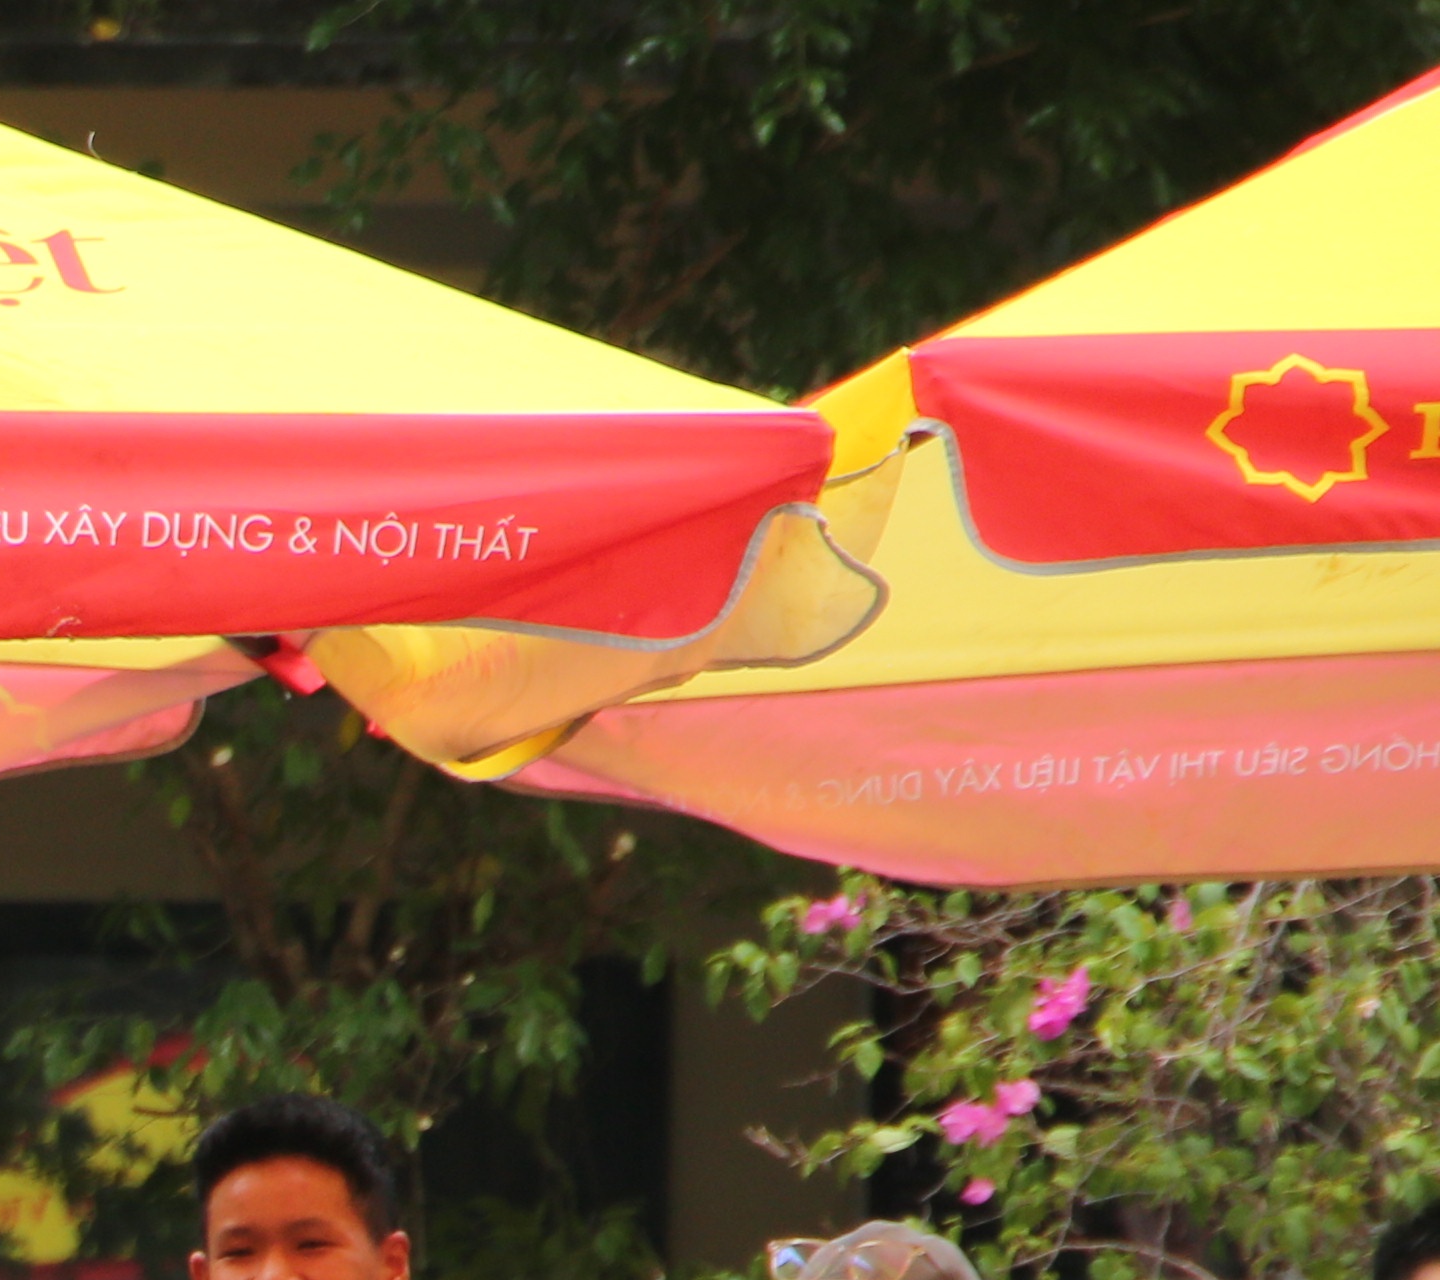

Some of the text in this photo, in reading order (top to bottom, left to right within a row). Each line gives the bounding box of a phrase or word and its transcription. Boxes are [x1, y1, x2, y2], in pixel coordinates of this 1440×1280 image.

[43, 504, 128, 547] XÂY
[141, 511, 274, 557] DỰNG
[288, 517, 318, 555] &
[333, 511, 419, 566] NỘI
[431, 515, 538, 561] THẤT
